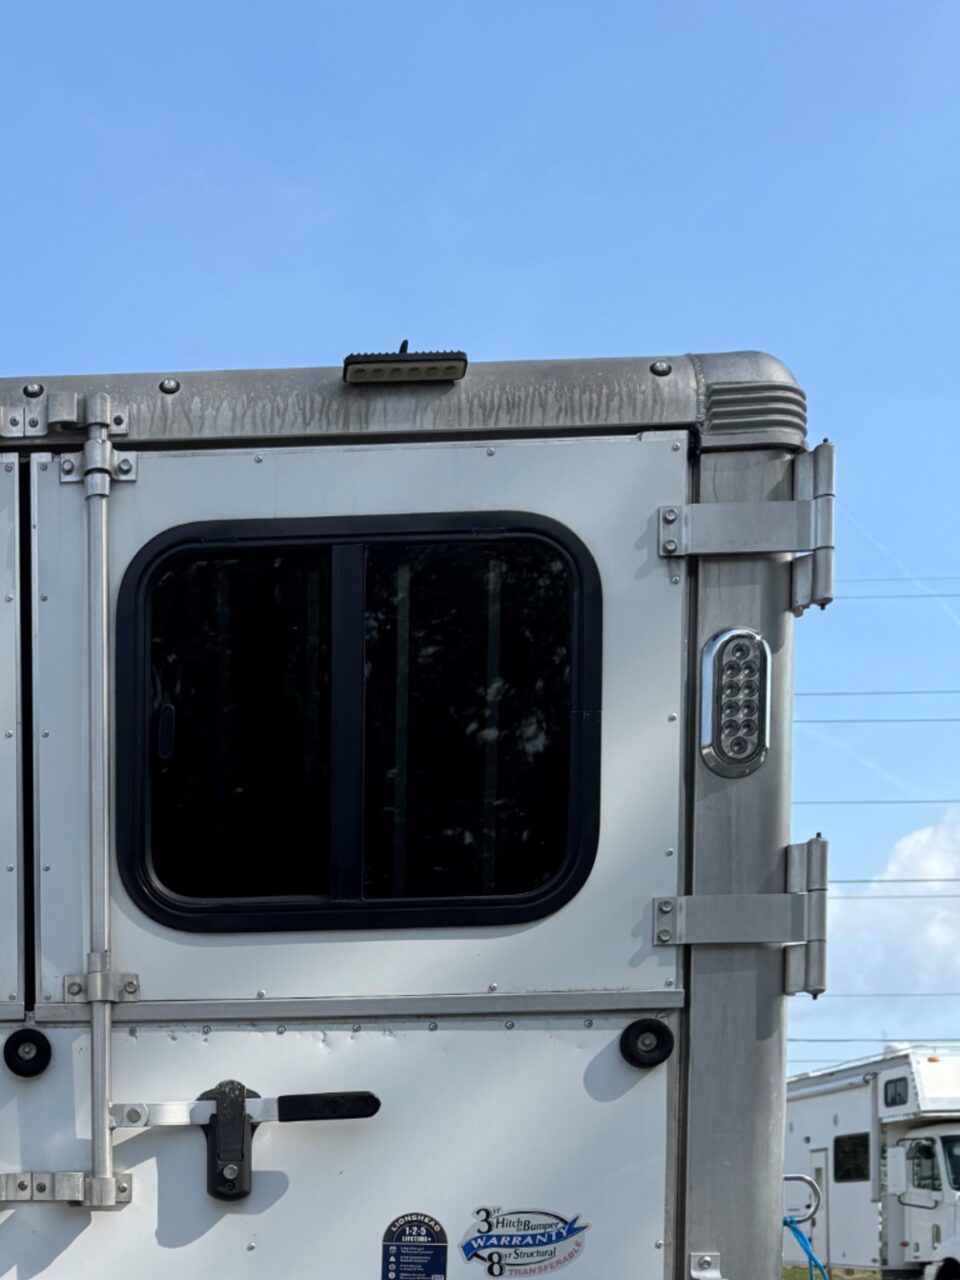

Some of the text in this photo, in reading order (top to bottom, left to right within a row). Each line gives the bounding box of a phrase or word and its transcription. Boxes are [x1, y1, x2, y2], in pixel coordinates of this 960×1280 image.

[391, 1214, 441, 1232] LIONSHEAD
[475, 1208, 494, 1234] 3
[495, 1217, 523, 1230] Hitch
[523, 1220, 559, 1232] Bumper
[471, 1225, 570, 1249] WARRANTY
[487, 1251, 504, 1277] 8
[513, 1247, 557, 1260] Structural
[508, 1239, 583, 1277] TRANSFERABLE
